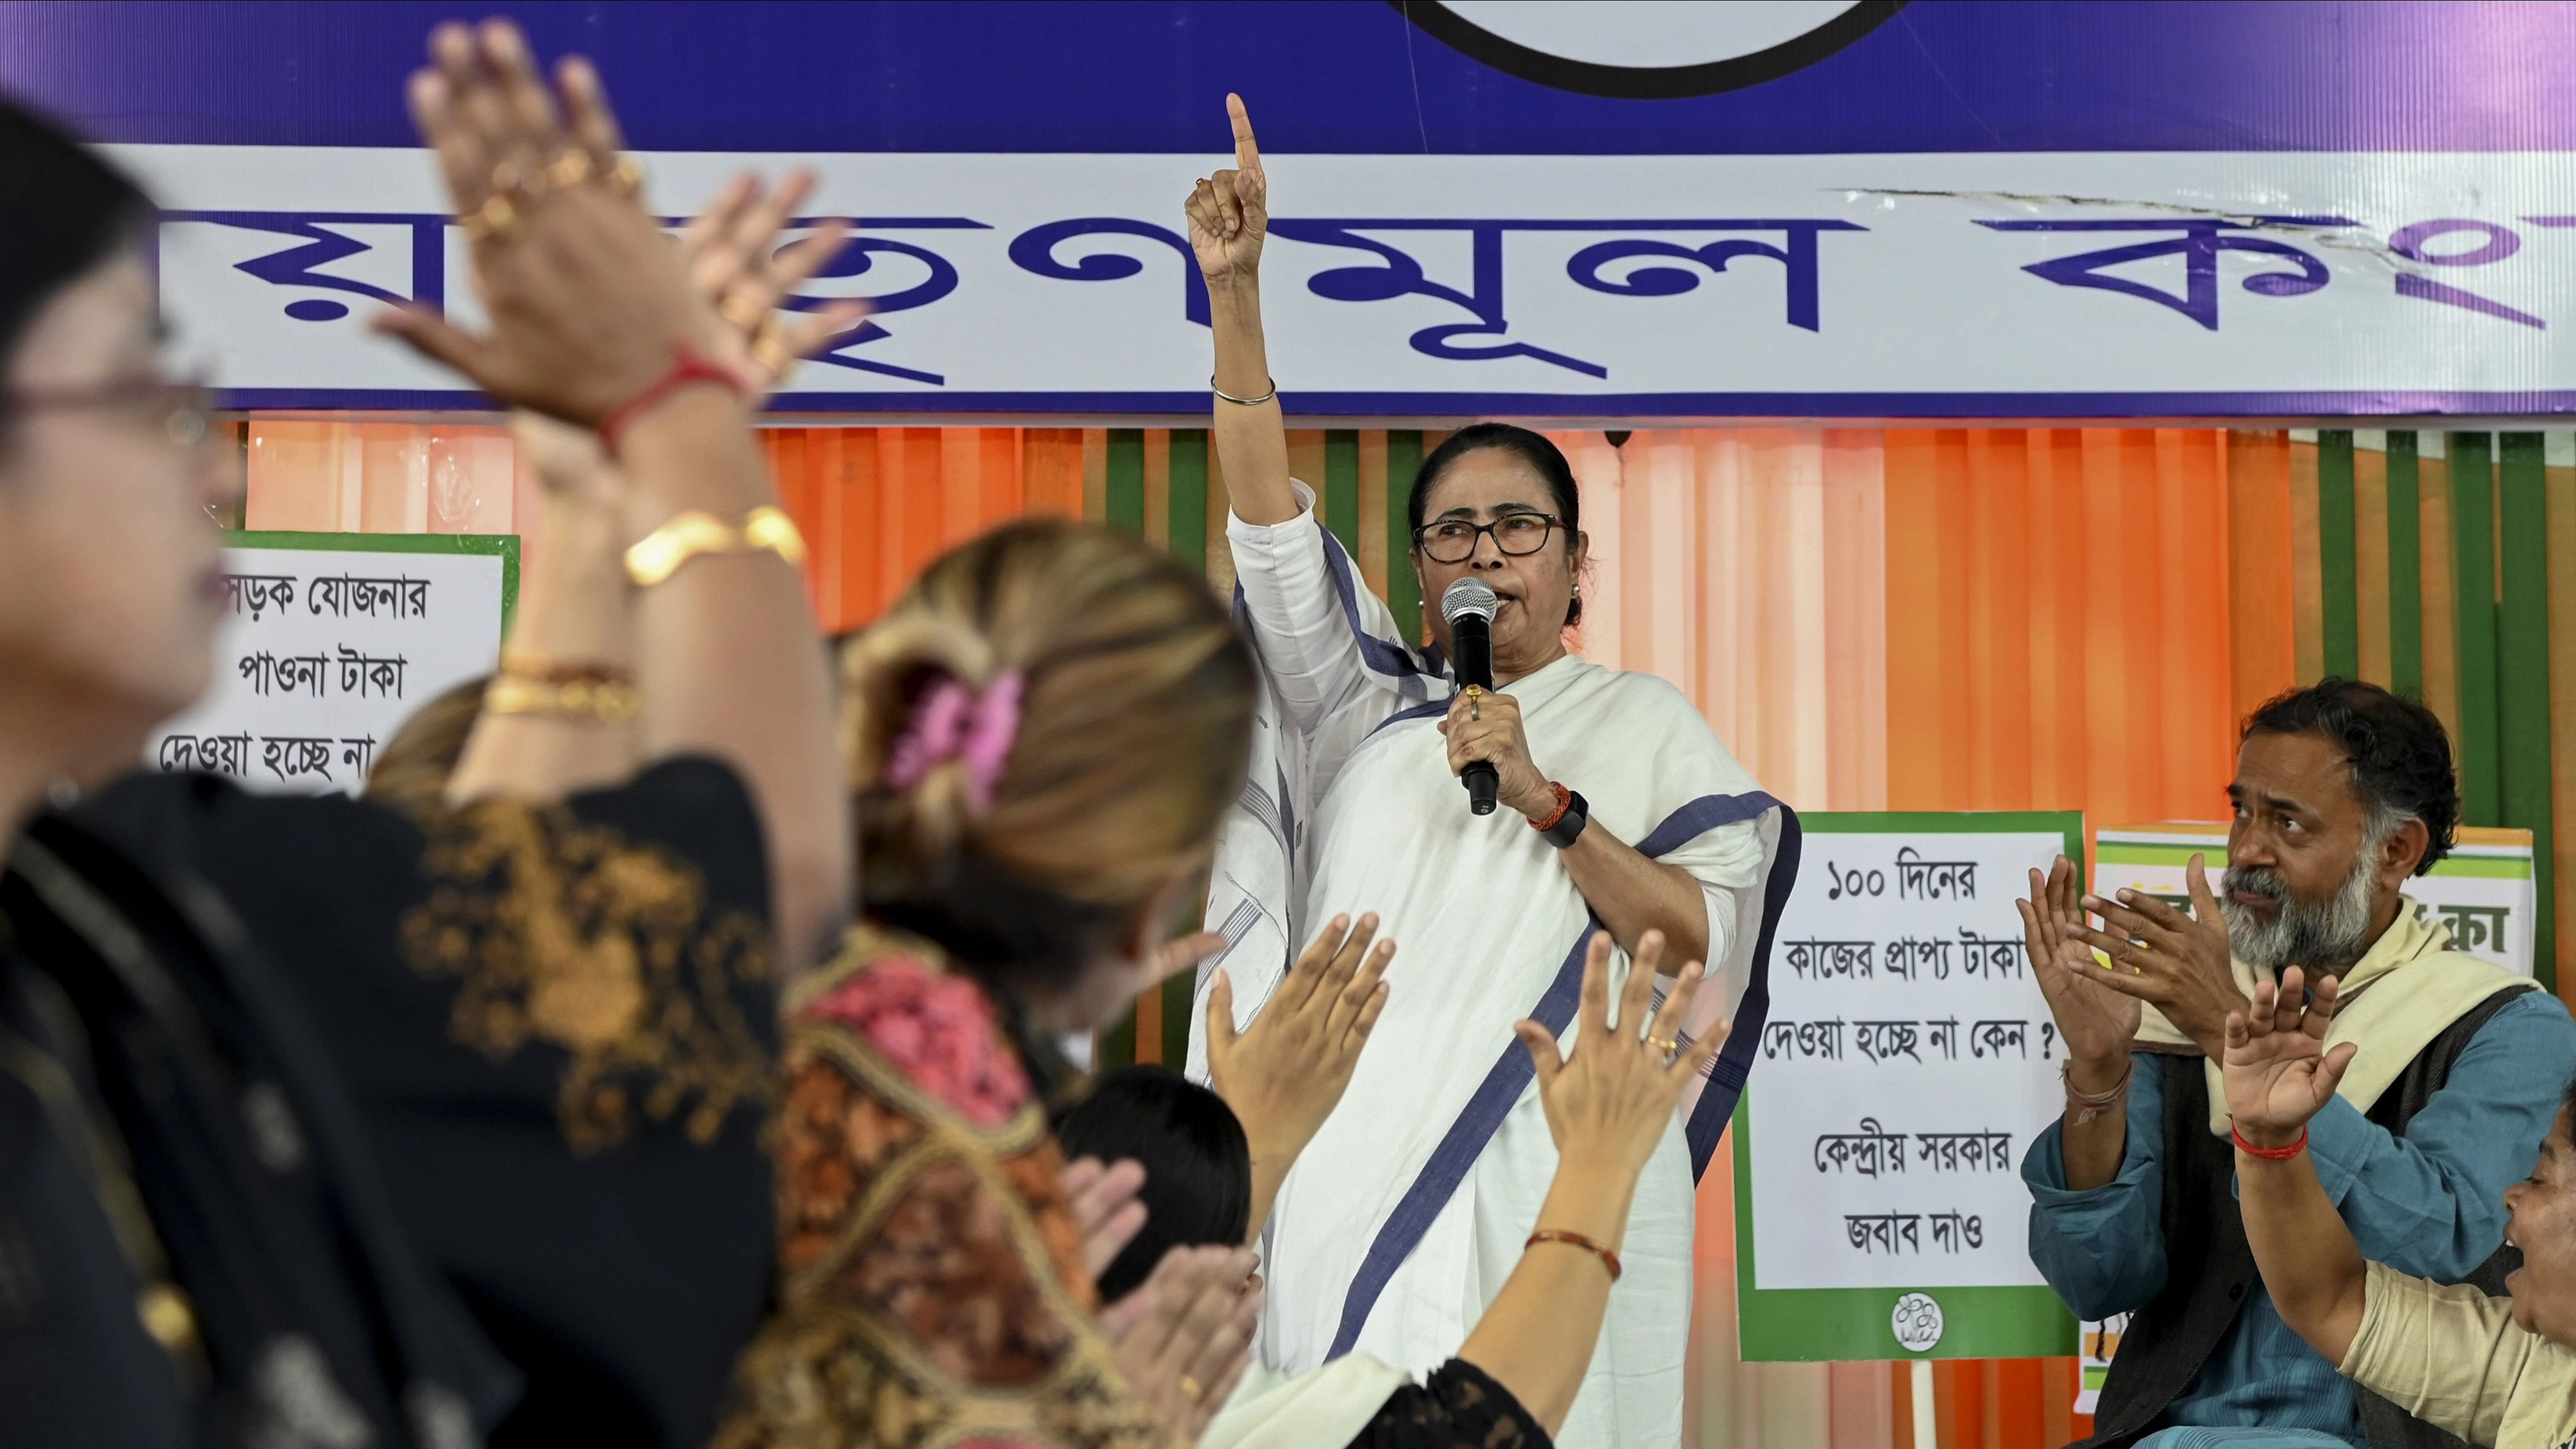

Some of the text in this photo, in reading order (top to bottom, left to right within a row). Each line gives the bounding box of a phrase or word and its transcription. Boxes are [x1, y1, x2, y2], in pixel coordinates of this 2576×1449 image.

[1970, 213, 2576, 331] কং
[308, 572, 431, 619] যোজনার
[239, 643, 407, 699] পাওনা টাকা
[160, 730, 377, 783] দেওয়া হচ্ছে না
[1829, 847, 1977, 900] ১০০ দিনের
[1783, 927, 2025, 980] কাজের প্রাপ্য টাকা
[1764, 1016, 2054, 1062] দেওয়া হচ্ছে না কেন ?
[1815, 1117, 2012, 1178] কেন্দ্রীয় সরকার
[1844, 1209, 1982, 1253] জবাব দাও
